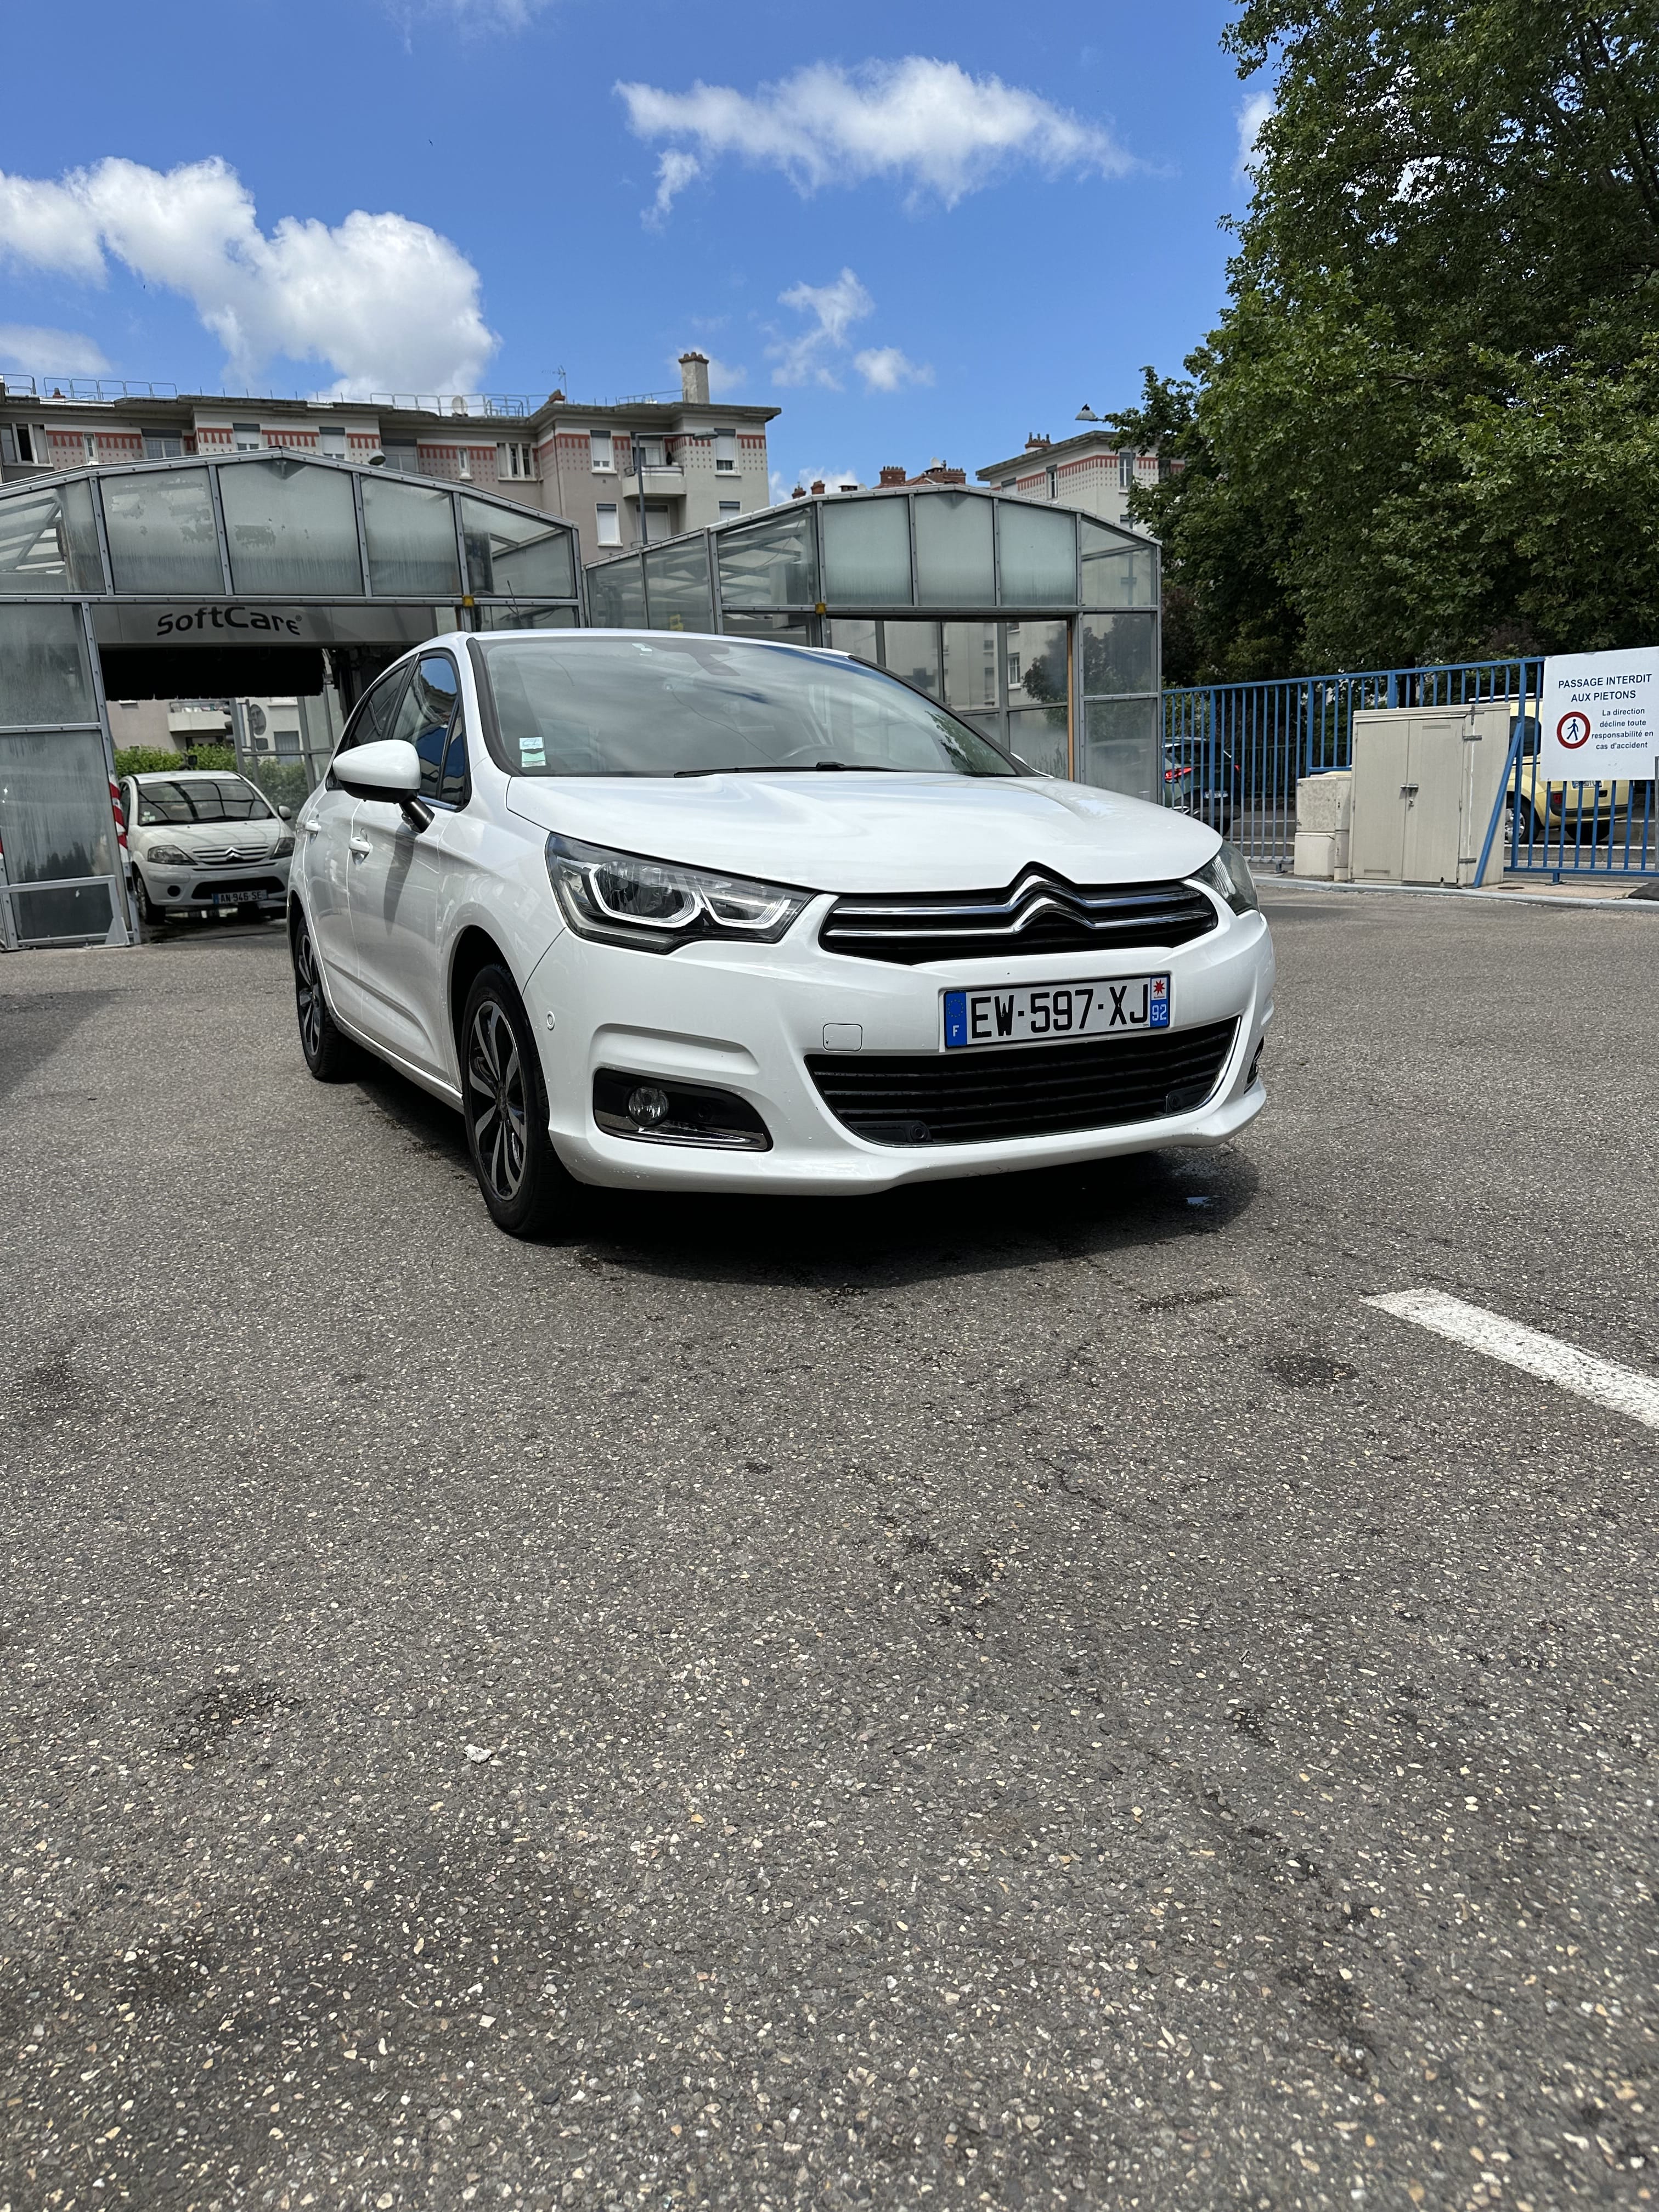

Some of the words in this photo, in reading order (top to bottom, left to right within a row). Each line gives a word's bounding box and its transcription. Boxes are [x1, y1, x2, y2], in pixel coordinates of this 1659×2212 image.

[1559, 678, 1603, 689] PASSAGE
[1606, 674, 1652, 685] INTERDIT
[1571, 693, 1590, 702] AUX
[1594, 690, 1636, 701] PIETONS
[1592, 731, 1642, 740] responsabilité
[1610, 741, 1648, 749] d'accident
[1152, 1004, 1167, 1021] 92
[952, 1025, 960, 1037] F
